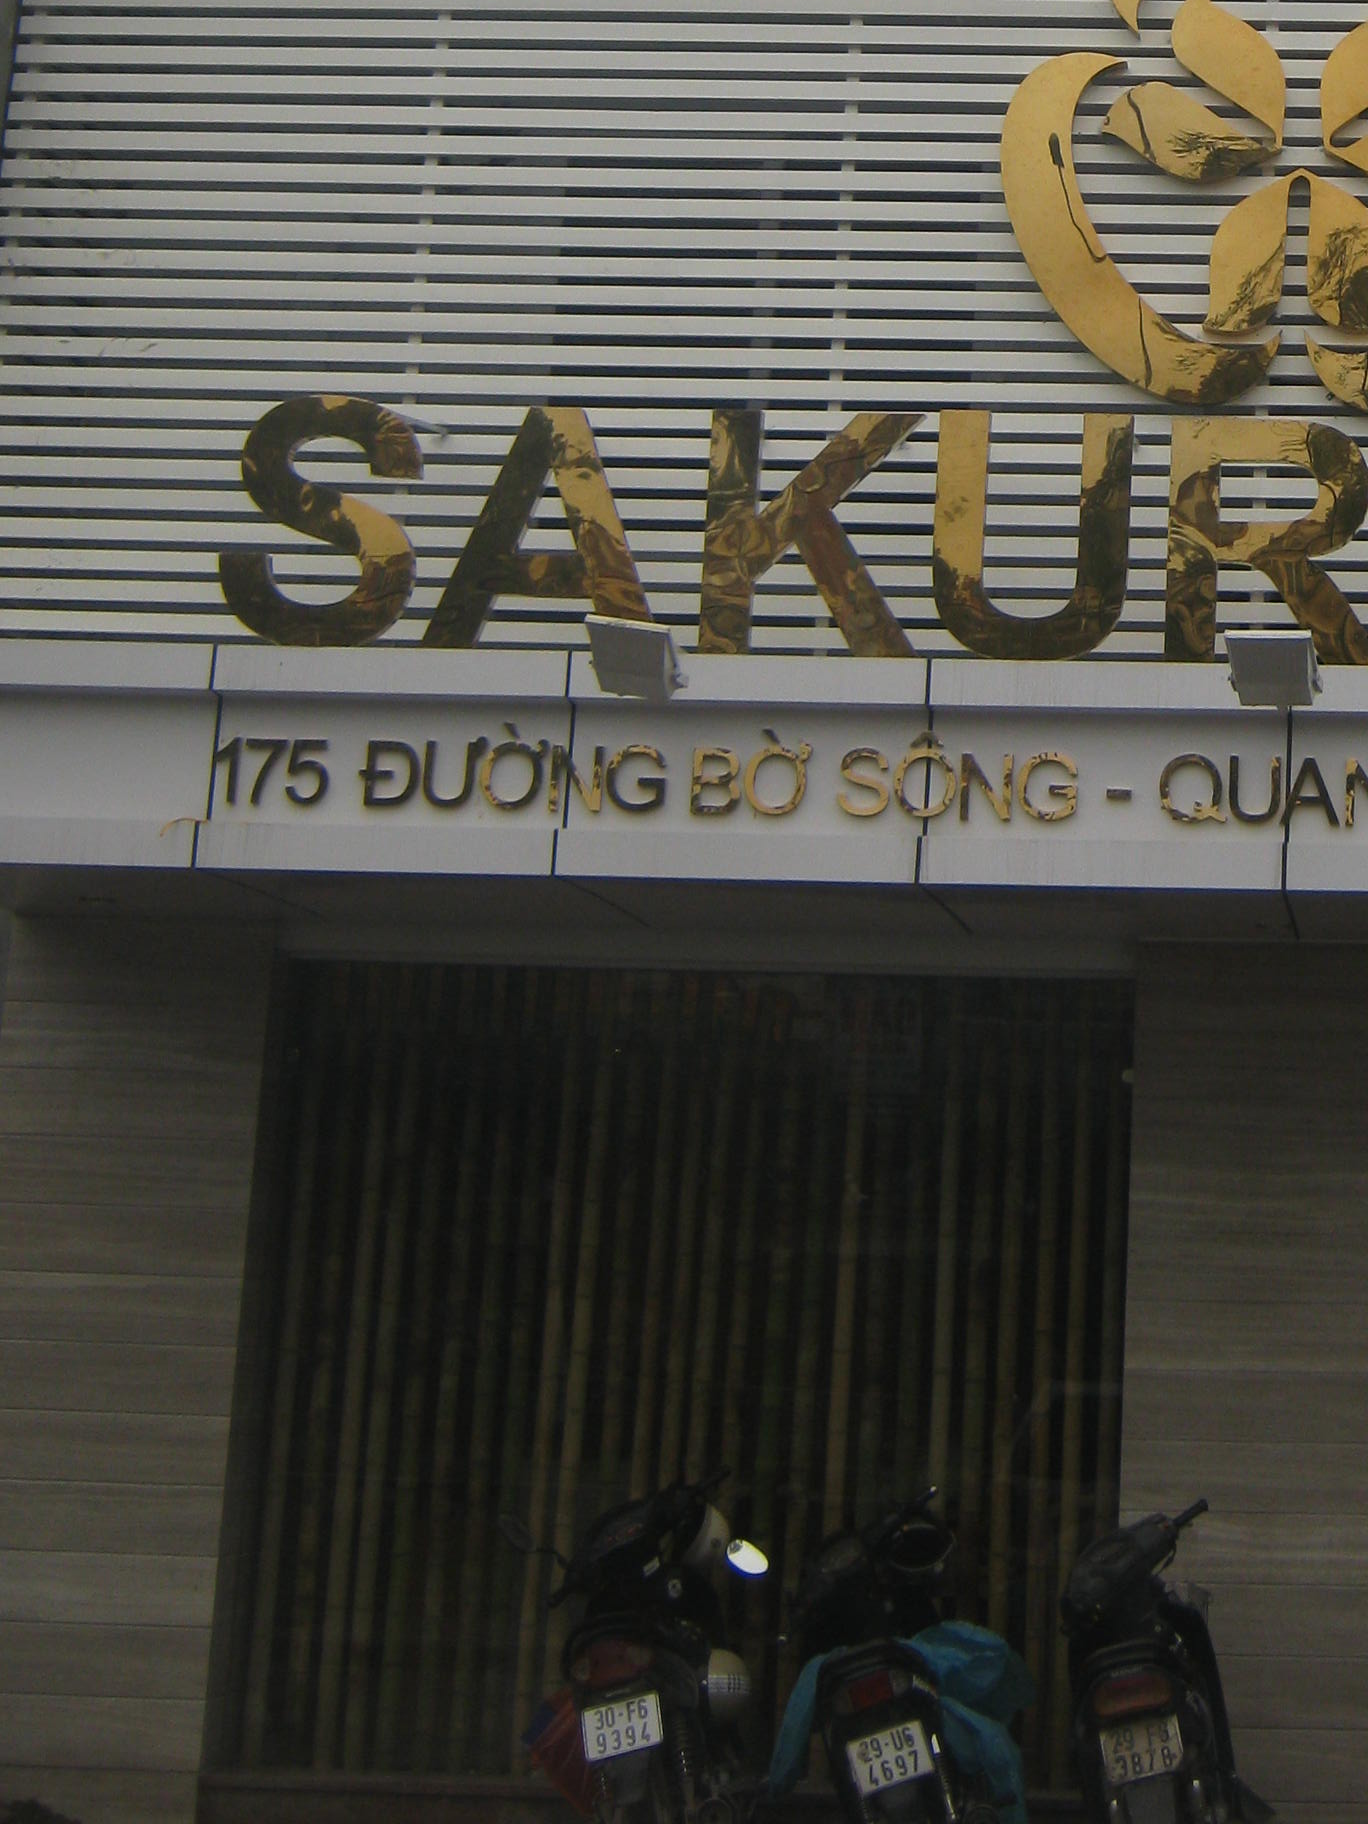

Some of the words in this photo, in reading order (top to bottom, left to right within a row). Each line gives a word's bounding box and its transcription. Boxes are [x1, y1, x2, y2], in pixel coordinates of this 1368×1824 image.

[213, 736, 330, 806] 175
[358, 722, 668, 813] ĐƯỜNG
[689, 728, 814, 817] BỜ
[836, 730, 1079, 822] SÔNG
[1106, 787, 1133, 801] -
[594, 1698, 649, 1730] 30-F6
[596, 1721, 651, 1754] 9394
[869, 1749, 919, 1786] 4697
